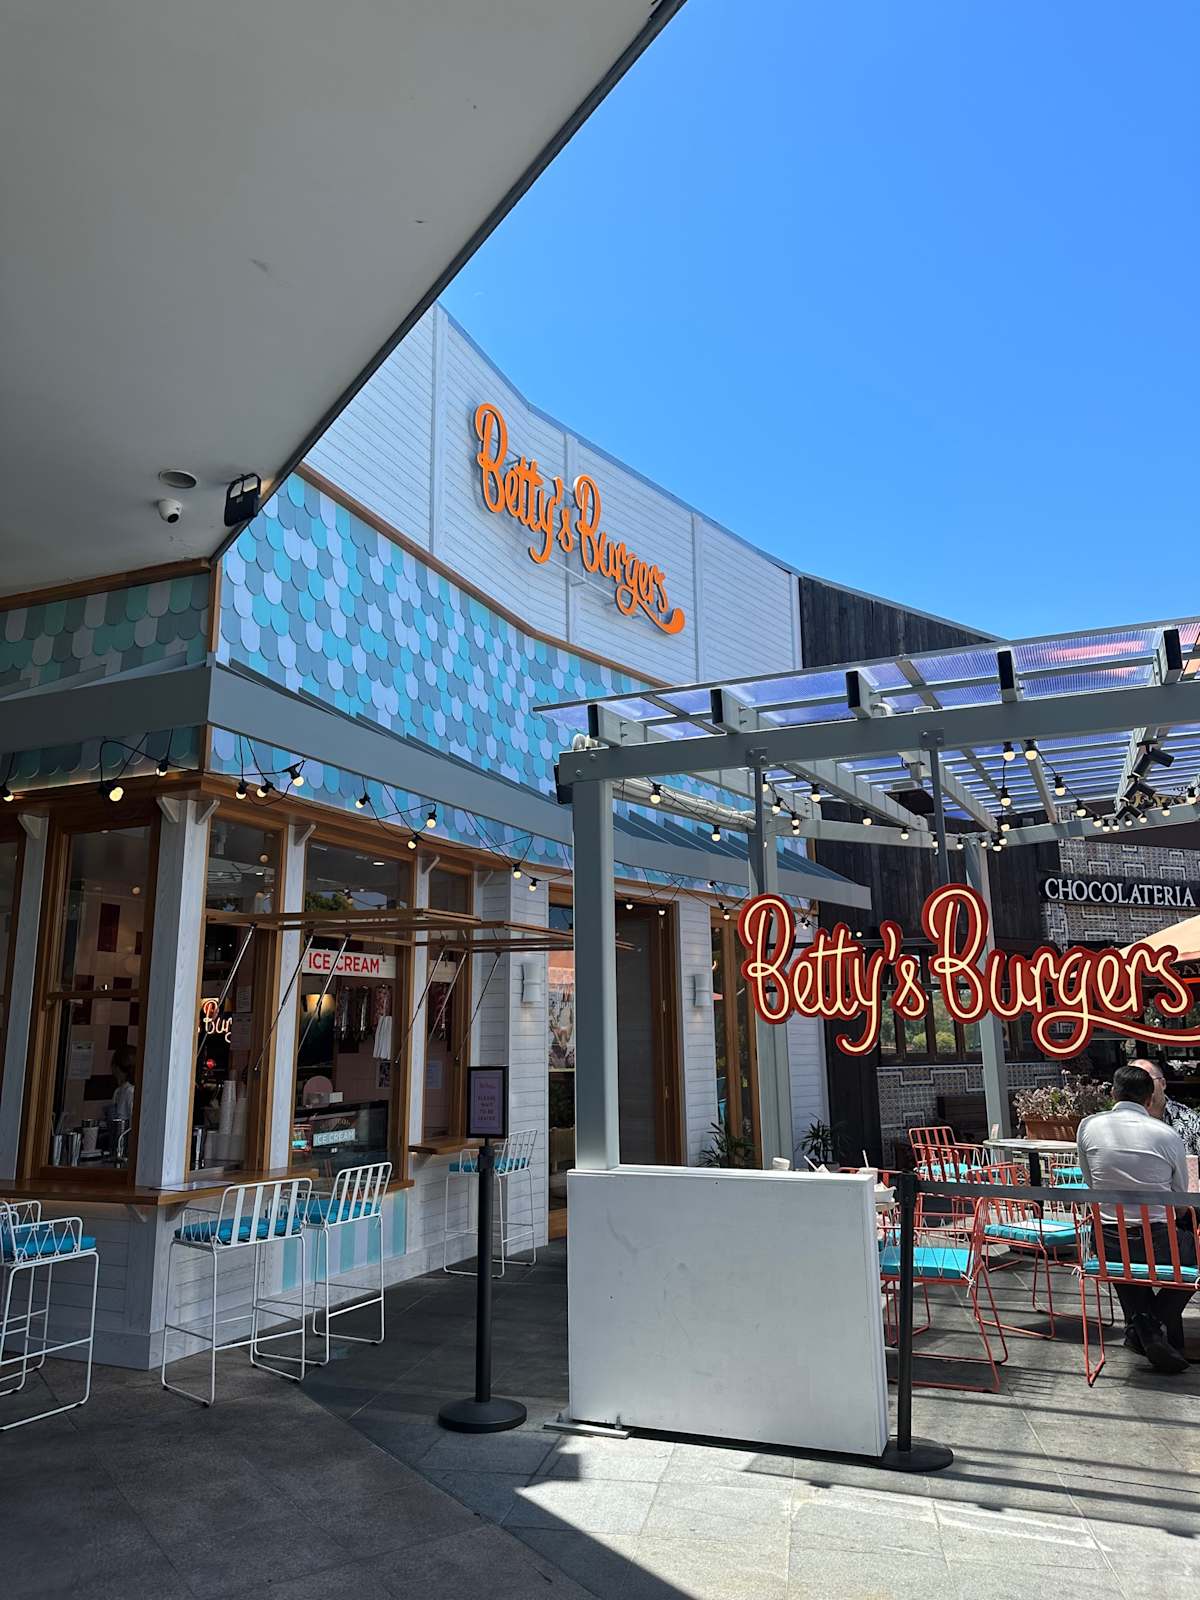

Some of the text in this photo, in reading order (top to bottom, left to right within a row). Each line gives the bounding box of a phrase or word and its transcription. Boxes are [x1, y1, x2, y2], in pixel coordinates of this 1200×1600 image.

[474, 402, 686, 635] Betty's Burgers
[1044, 878, 1196, 907] CHOCOLATERIA
[308, 952, 380, 974] ICE CREAM
[737, 883, 1200, 1059] Betty's Burgers
[315, 1131, 355, 1145] ICE CREAM
